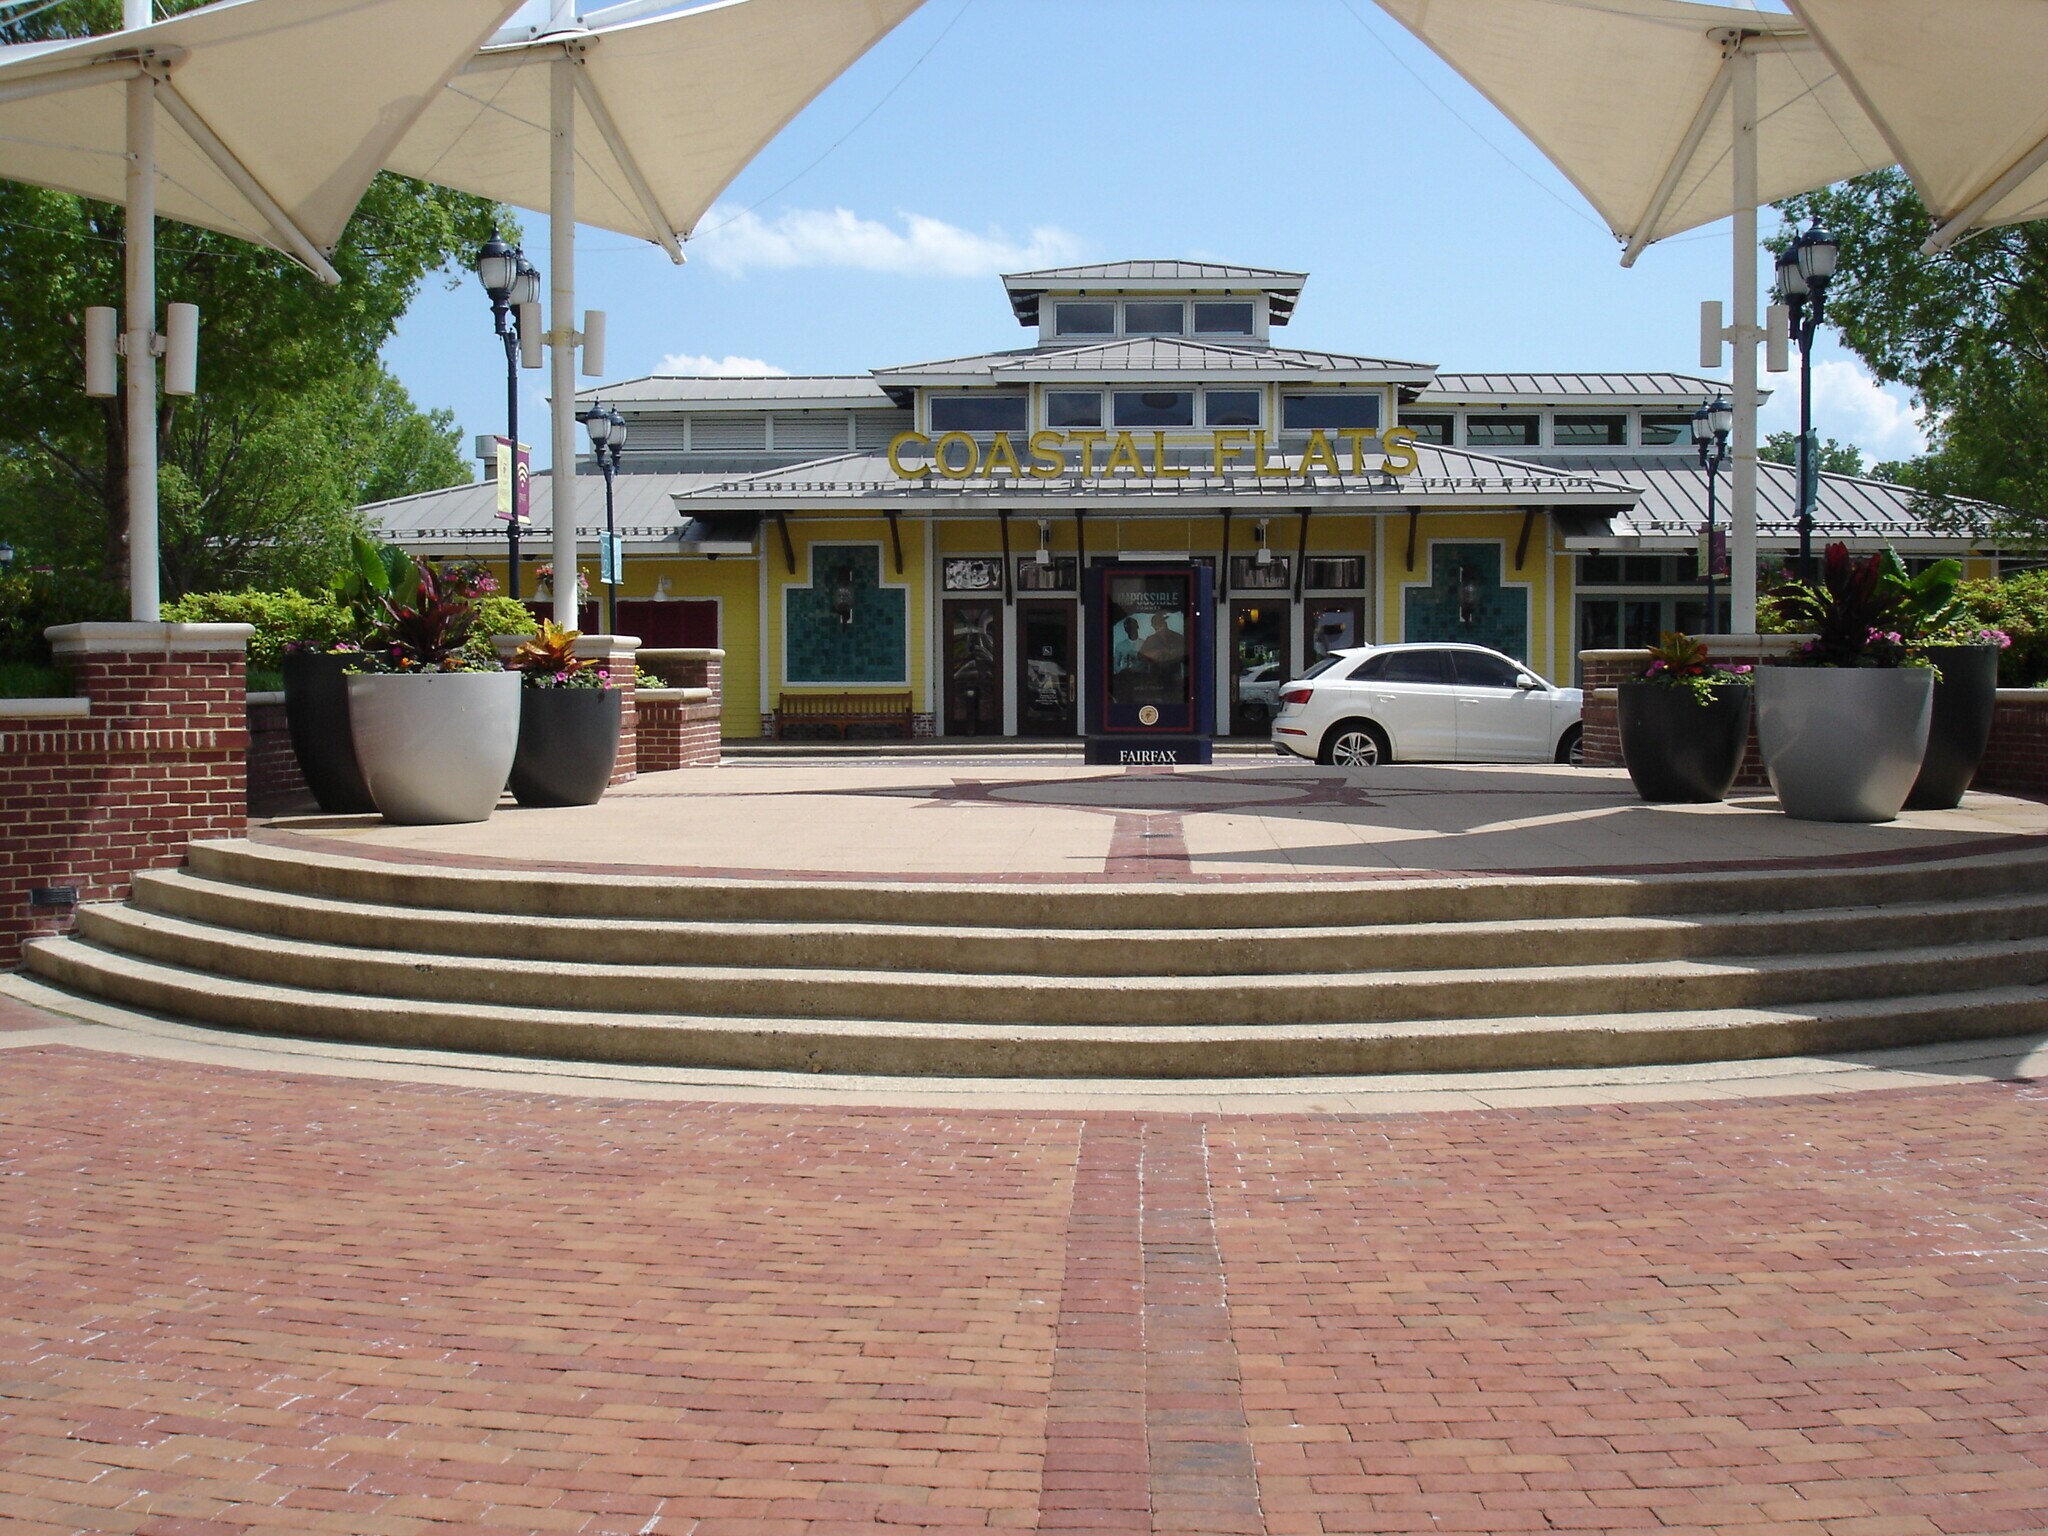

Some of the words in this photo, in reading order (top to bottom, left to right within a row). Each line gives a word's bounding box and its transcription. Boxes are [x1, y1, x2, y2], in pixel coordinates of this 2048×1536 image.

[888, 430, 1191, 480] COASTAL
[1213, 427, 1418, 478] FLATS
[1117, 592, 1179, 606] IMPOSSIBLE
[1119, 750, 1177, 762] FAIRFAX
